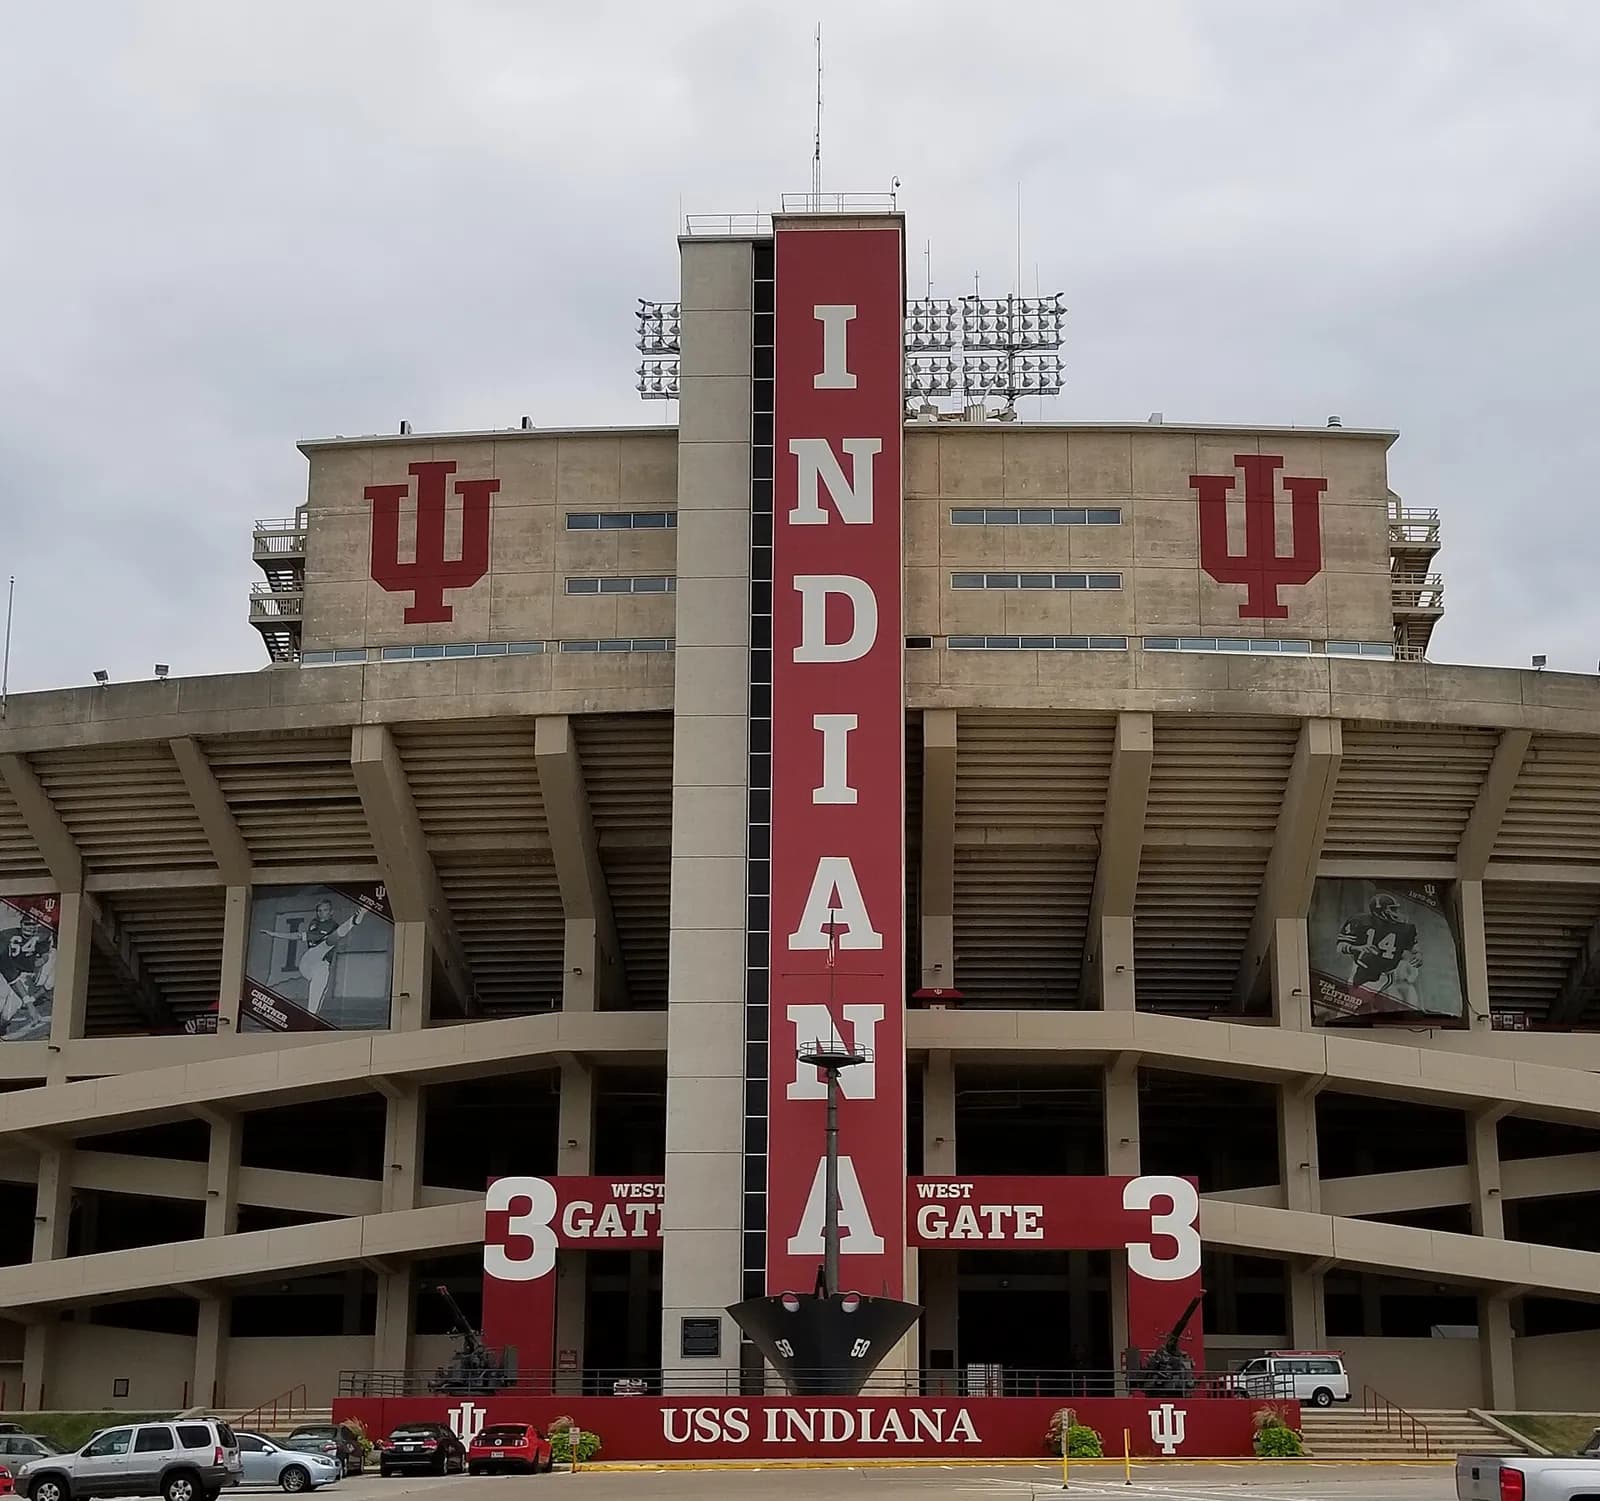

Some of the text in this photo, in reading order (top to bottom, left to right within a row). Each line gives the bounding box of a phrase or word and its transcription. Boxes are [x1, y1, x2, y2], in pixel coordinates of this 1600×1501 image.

[787, 304, 885, 1254] INDIANA
[1366, 929, 1397, 959] 14
[251, 989, 275, 1006] CHRIS
[611, 1184, 665, 1198] WEST
[917, 1184, 973, 1198] WEST
[484, 1176, 559, 1281] 3
[562, 1200, 664, 1238] GAT
[917, 1205, 1044, 1240] GATE
[1123, 1175, 1201, 1281] 3
[775, 1339, 794, 1358] 58
[850, 1338, 871, 1358] 58
[660, 1407, 982, 1443] USS INDIANA
